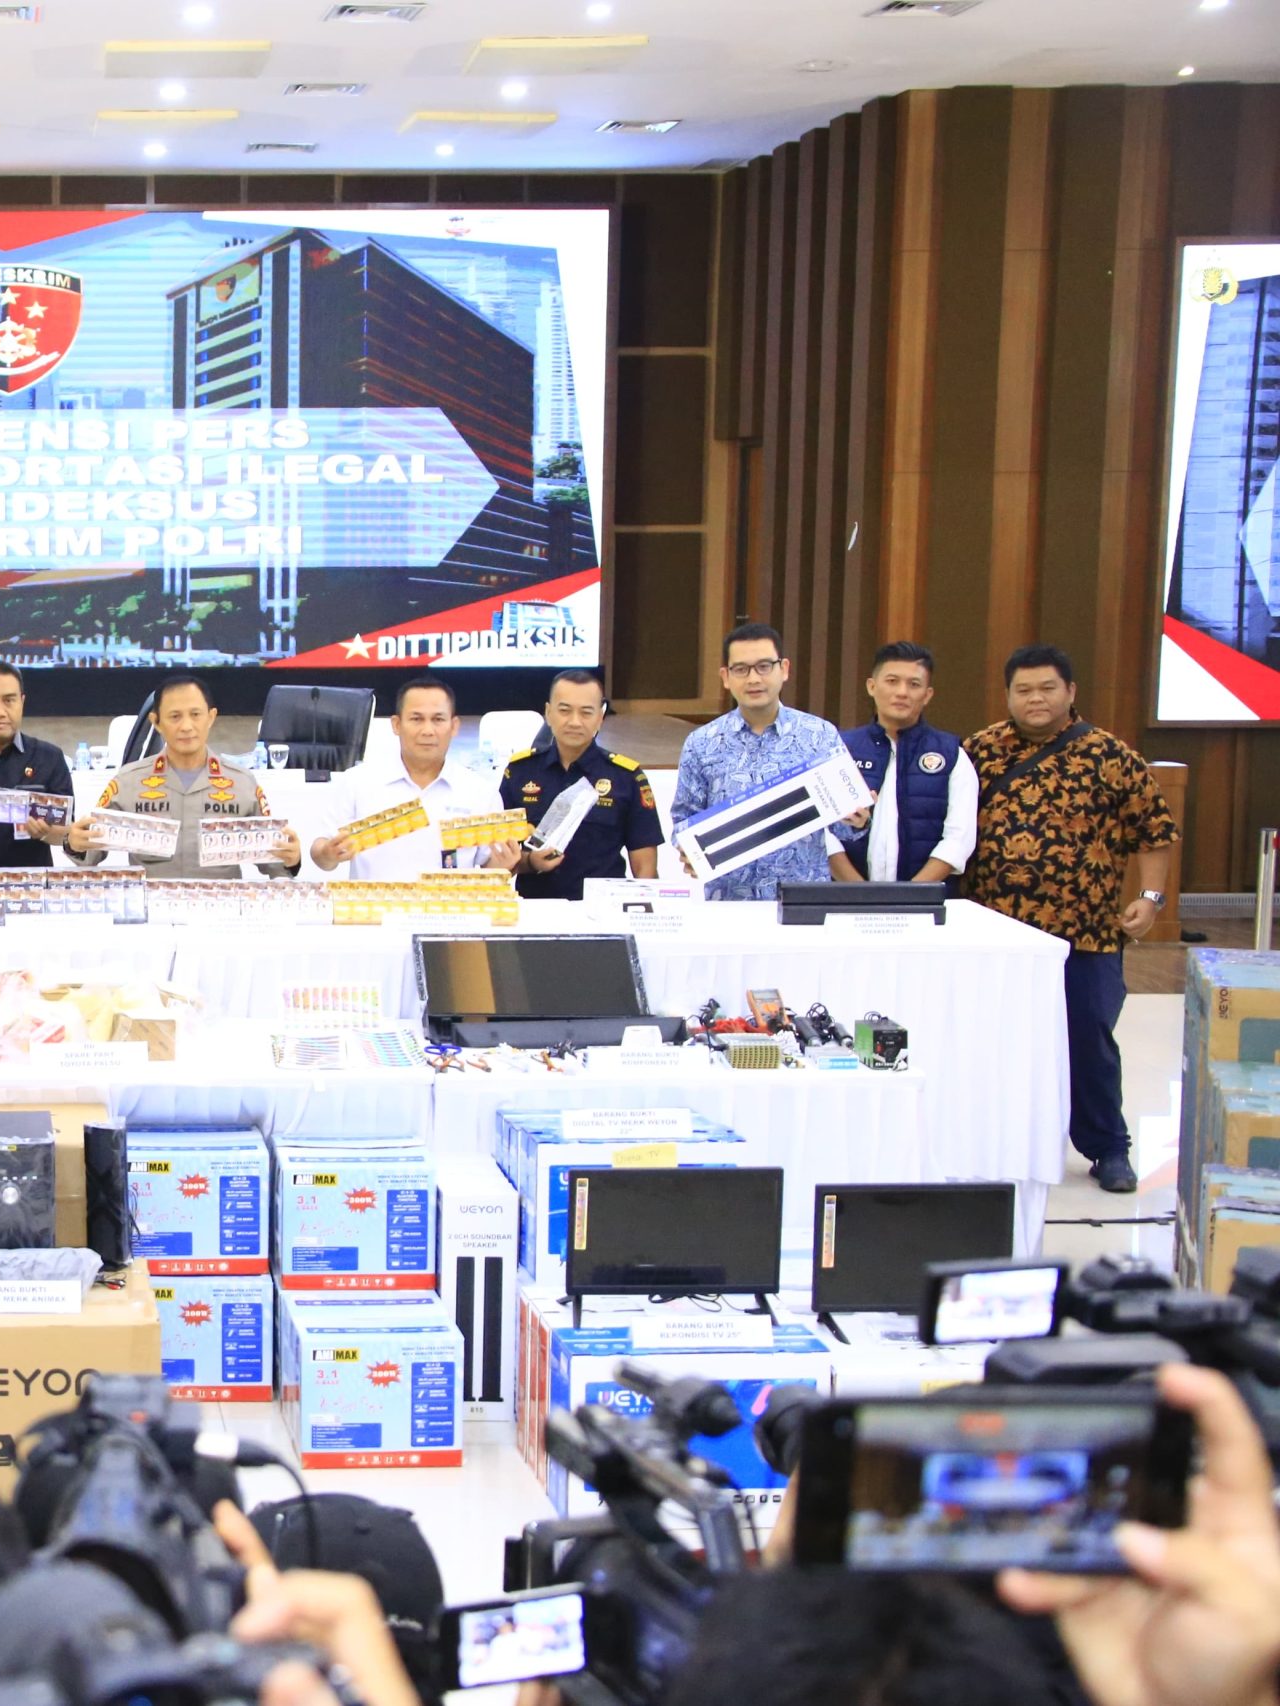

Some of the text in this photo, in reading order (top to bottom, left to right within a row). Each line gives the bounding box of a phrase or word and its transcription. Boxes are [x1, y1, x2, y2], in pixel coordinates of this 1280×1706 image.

[150, 418, 311, 449] PERS
[226, 453, 445, 485] ILEGAL
[123, 525, 304, 557] POLRI
[377, 626, 592, 661] DITTIPIDEKSUS
[839, 768, 860, 801] WEYON
[135, 801, 170, 813] HELFI
[204, 803, 239, 814] POLRI
[293, 1174, 337, 1186] ANIMAX
[459, 1204, 504, 1214] WEYON
[3, 1295, 29, 1303] MERK
[31, 1295, 67, 1303] ANIMAX
[665, 1321, 735, 1330] BARANG BUKTI
[312, 1350, 358, 1361] ANIMAX
